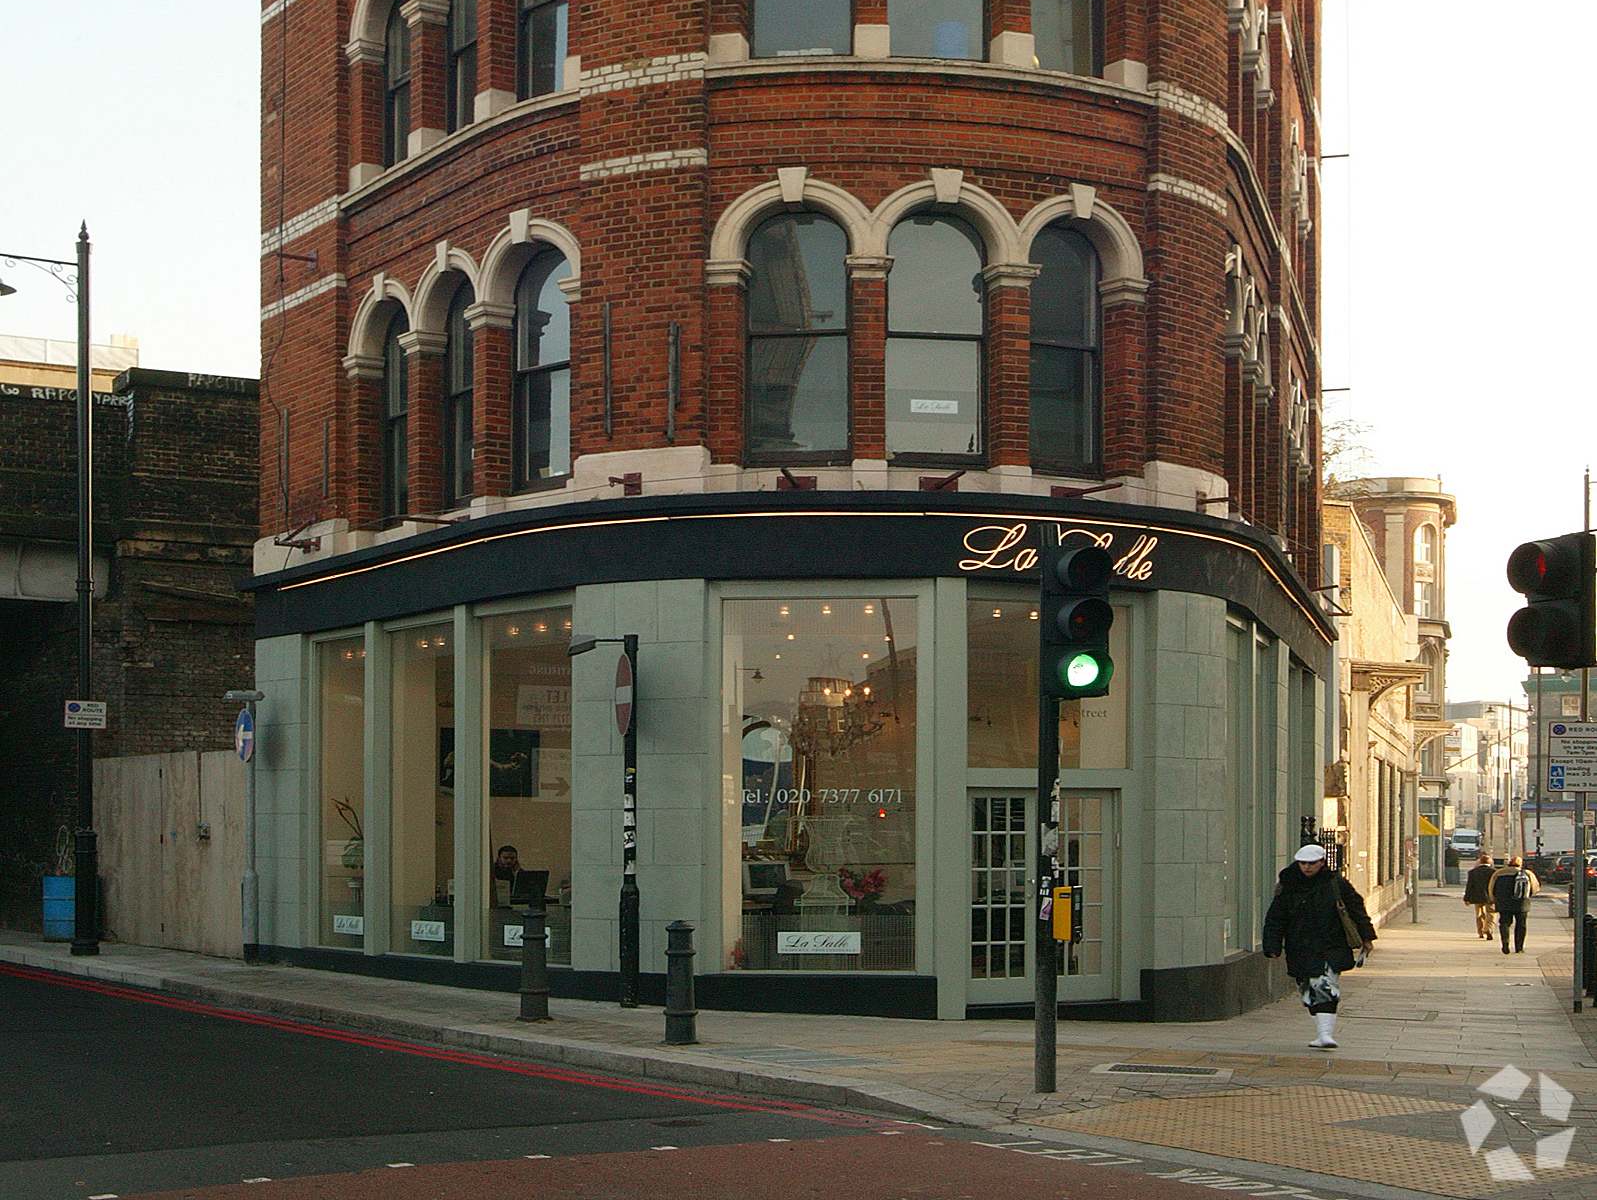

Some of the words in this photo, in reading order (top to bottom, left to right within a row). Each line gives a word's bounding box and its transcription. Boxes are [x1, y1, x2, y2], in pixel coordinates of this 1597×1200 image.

[958, 523, 1039, 571] La
[1058, 529, 1159, 580] lle
[776, 788, 811, 804] 020
[818, 788, 861, 804] 7377
[867, 788, 903, 804] 6171
[785, 934, 809, 948] La
[813, 934, 851, 948] Salle
[970, 1140, 1143, 1167] LEFT
[1147, 1167, 1313, 1197] LOOK
